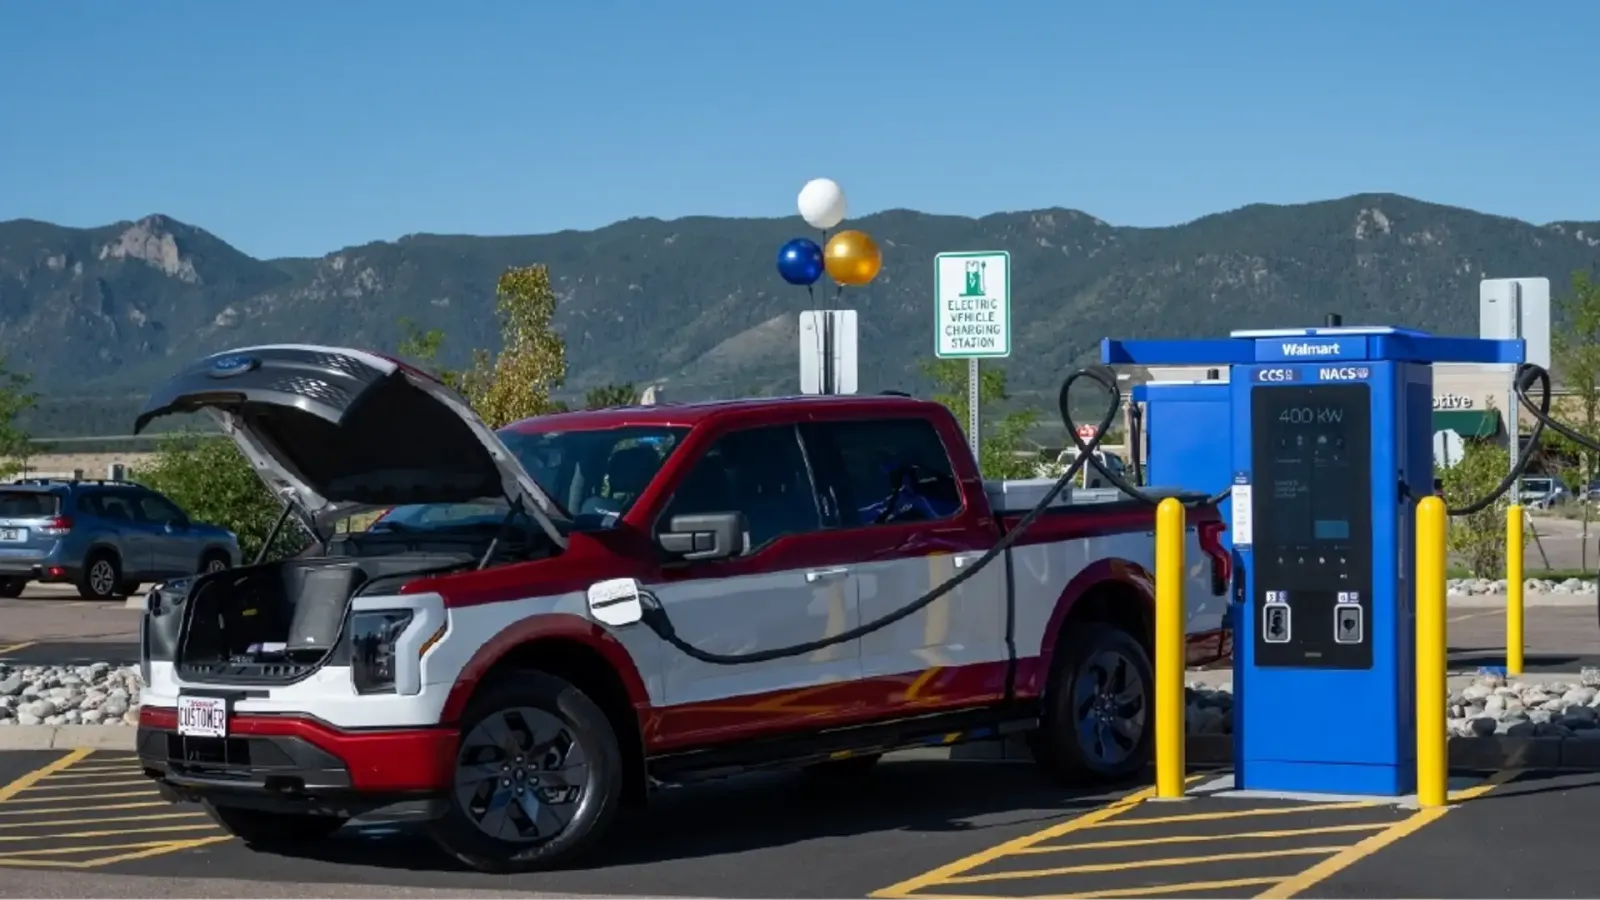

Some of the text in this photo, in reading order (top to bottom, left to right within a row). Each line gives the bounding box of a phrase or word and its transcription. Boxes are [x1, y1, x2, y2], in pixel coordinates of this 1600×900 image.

[948, 299, 998, 310] ELECTRIC
[950, 311, 995, 322] VEHICLE
[945, 324, 1001, 336] CHARGING
[951, 337, 995, 348] STATION
[1282, 343, 1340, 355] Walmart
[1259, 369, 1285, 381] CCS
[1320, 367, 1356, 380] NACS
[1279, 407, 1343, 423] 400 kW
[179, 707, 225, 729] CUSTOMER
